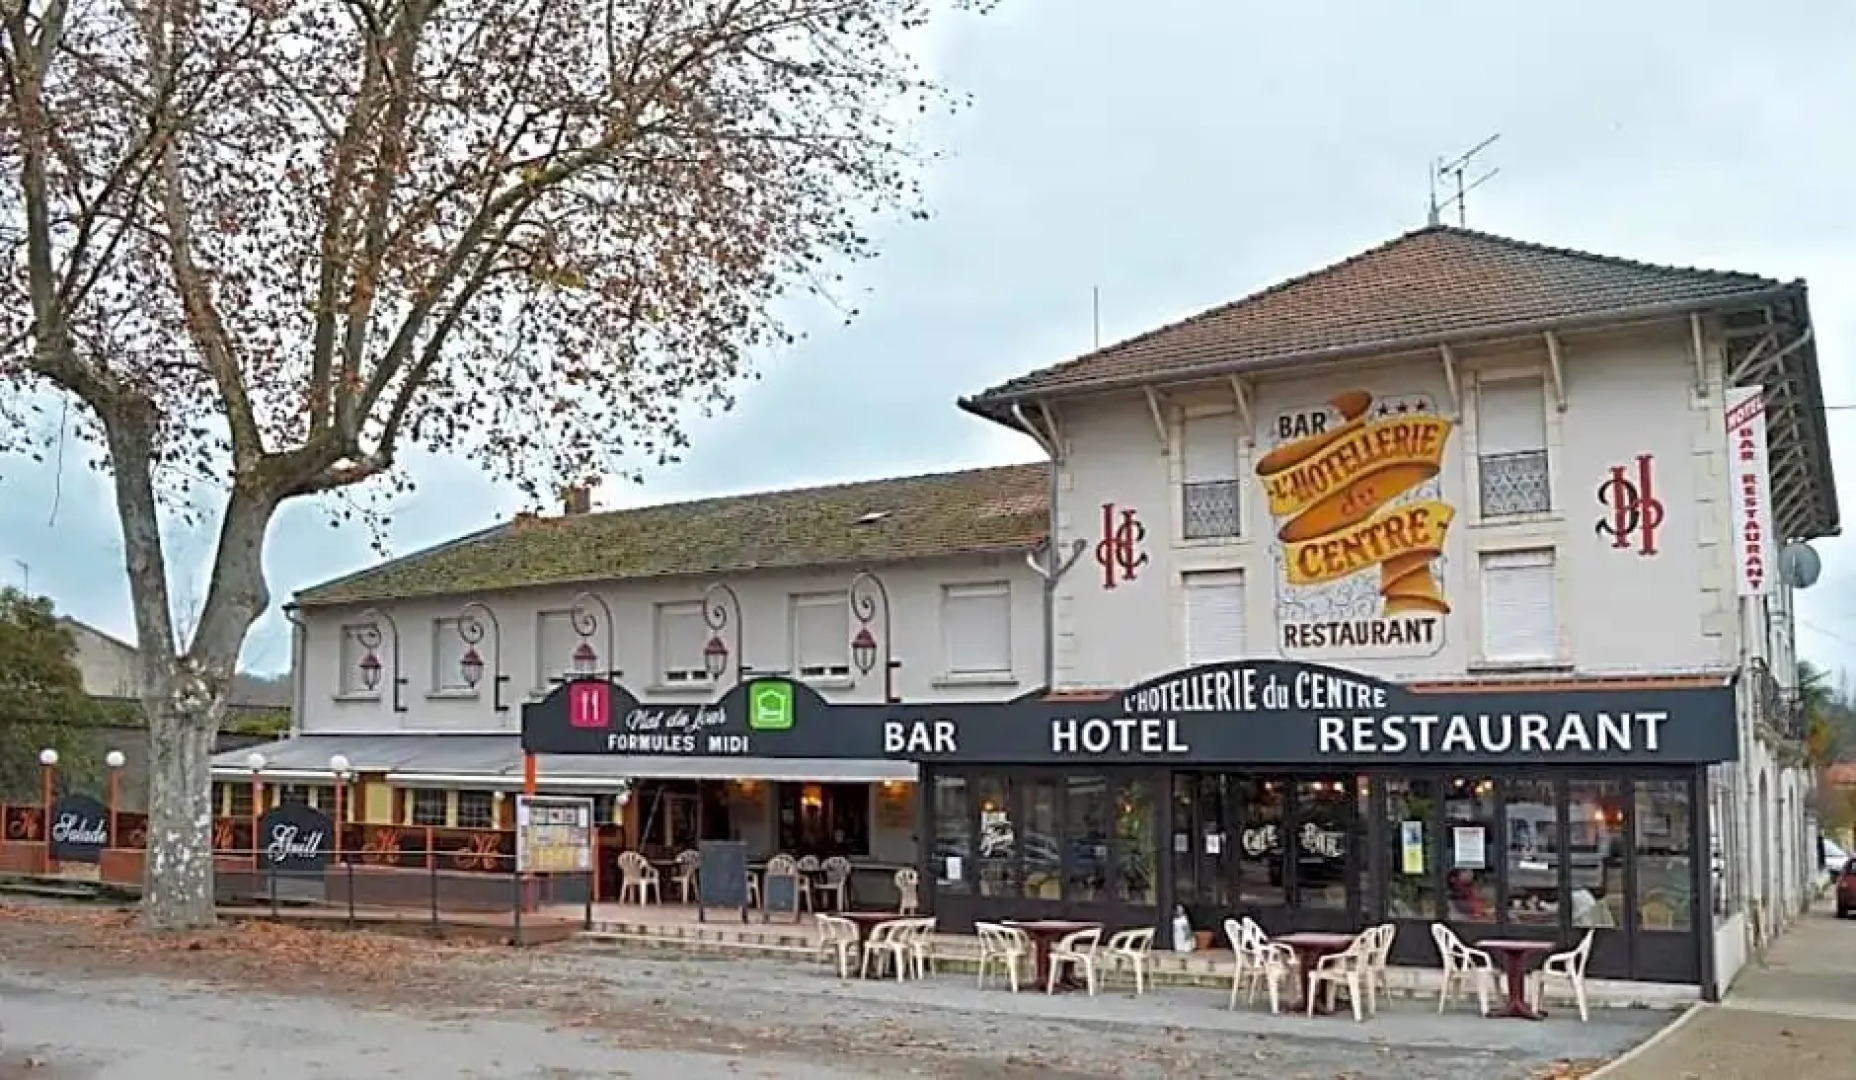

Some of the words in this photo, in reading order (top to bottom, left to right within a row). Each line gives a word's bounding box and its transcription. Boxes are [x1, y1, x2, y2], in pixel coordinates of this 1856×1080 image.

[1279, 412, 1327, 439] BAR
[1739, 428, 1754, 460] BAR
[1272, 421, 1439, 501] L'HOTELLERIE
[1298, 508, 1430, 579] CENTRE
[1742, 474, 1764, 589] RESTAURANT
[1284, 617, 1437, 649] RESTAURANT
[1123, 669, 1257, 713] L'HOTELLERIE
[1263, 674, 1289, 710] du
[1295, 671, 1387, 709] CENTRE
[607, 734, 696, 751] FORMULES
[708, 736, 749, 752] MIDI
[884, 721, 956, 752] BAR
[1052, 719, 1189, 752] HOTEL
[1319, 712, 1667, 752] RESTAURANT
[53, 812, 107, 844] Salade
[267, 824, 325, 862] Grill
